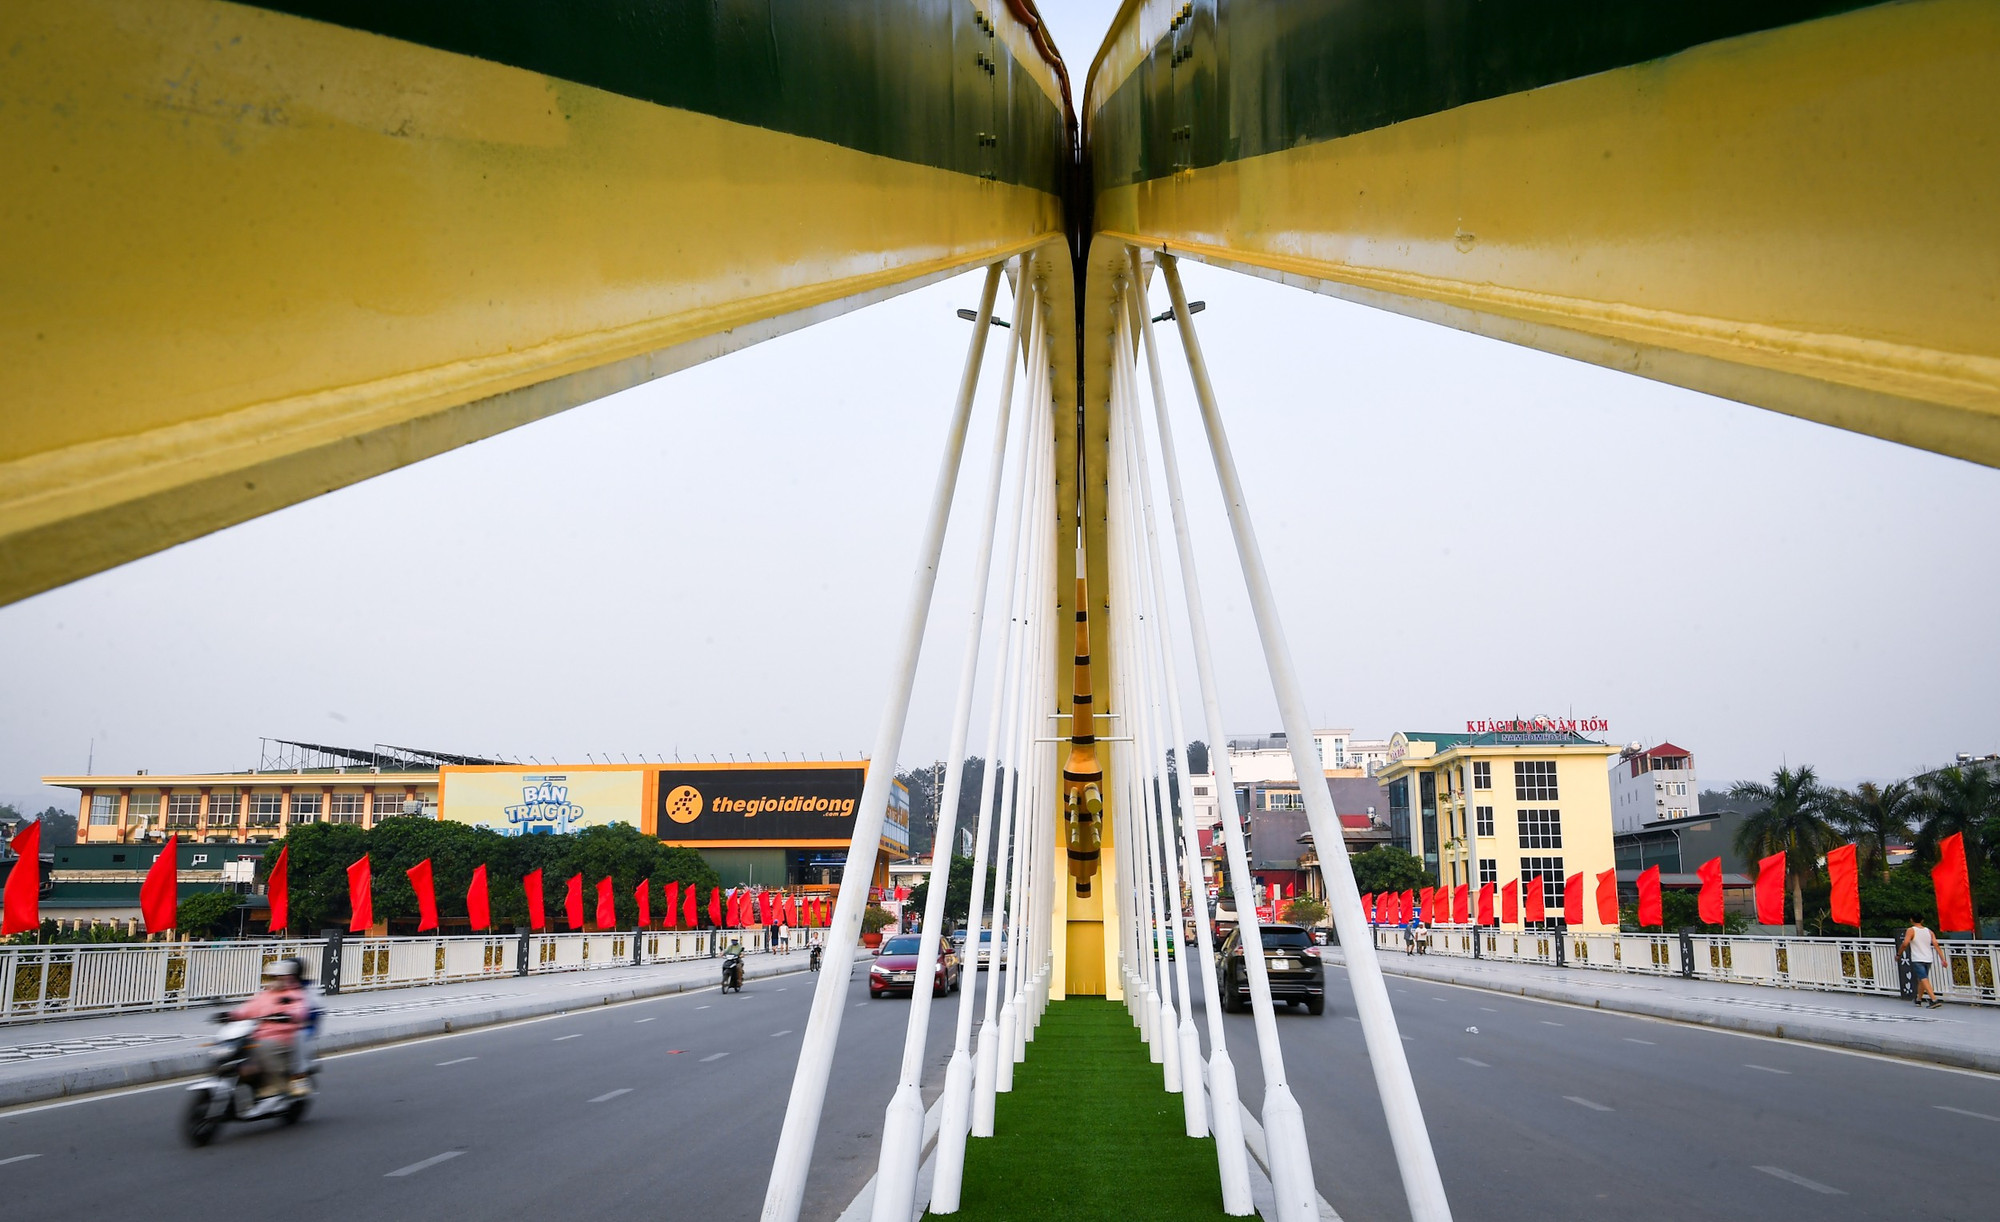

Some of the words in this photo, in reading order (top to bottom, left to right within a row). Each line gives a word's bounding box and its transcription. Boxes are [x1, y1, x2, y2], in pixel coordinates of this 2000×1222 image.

[1467, 717, 1514, 732] KHÁCH
[523, 782, 568, 805] BÁN
[544, 801, 584, 823] GÓP
[712, 796, 856, 818] thegioididong
